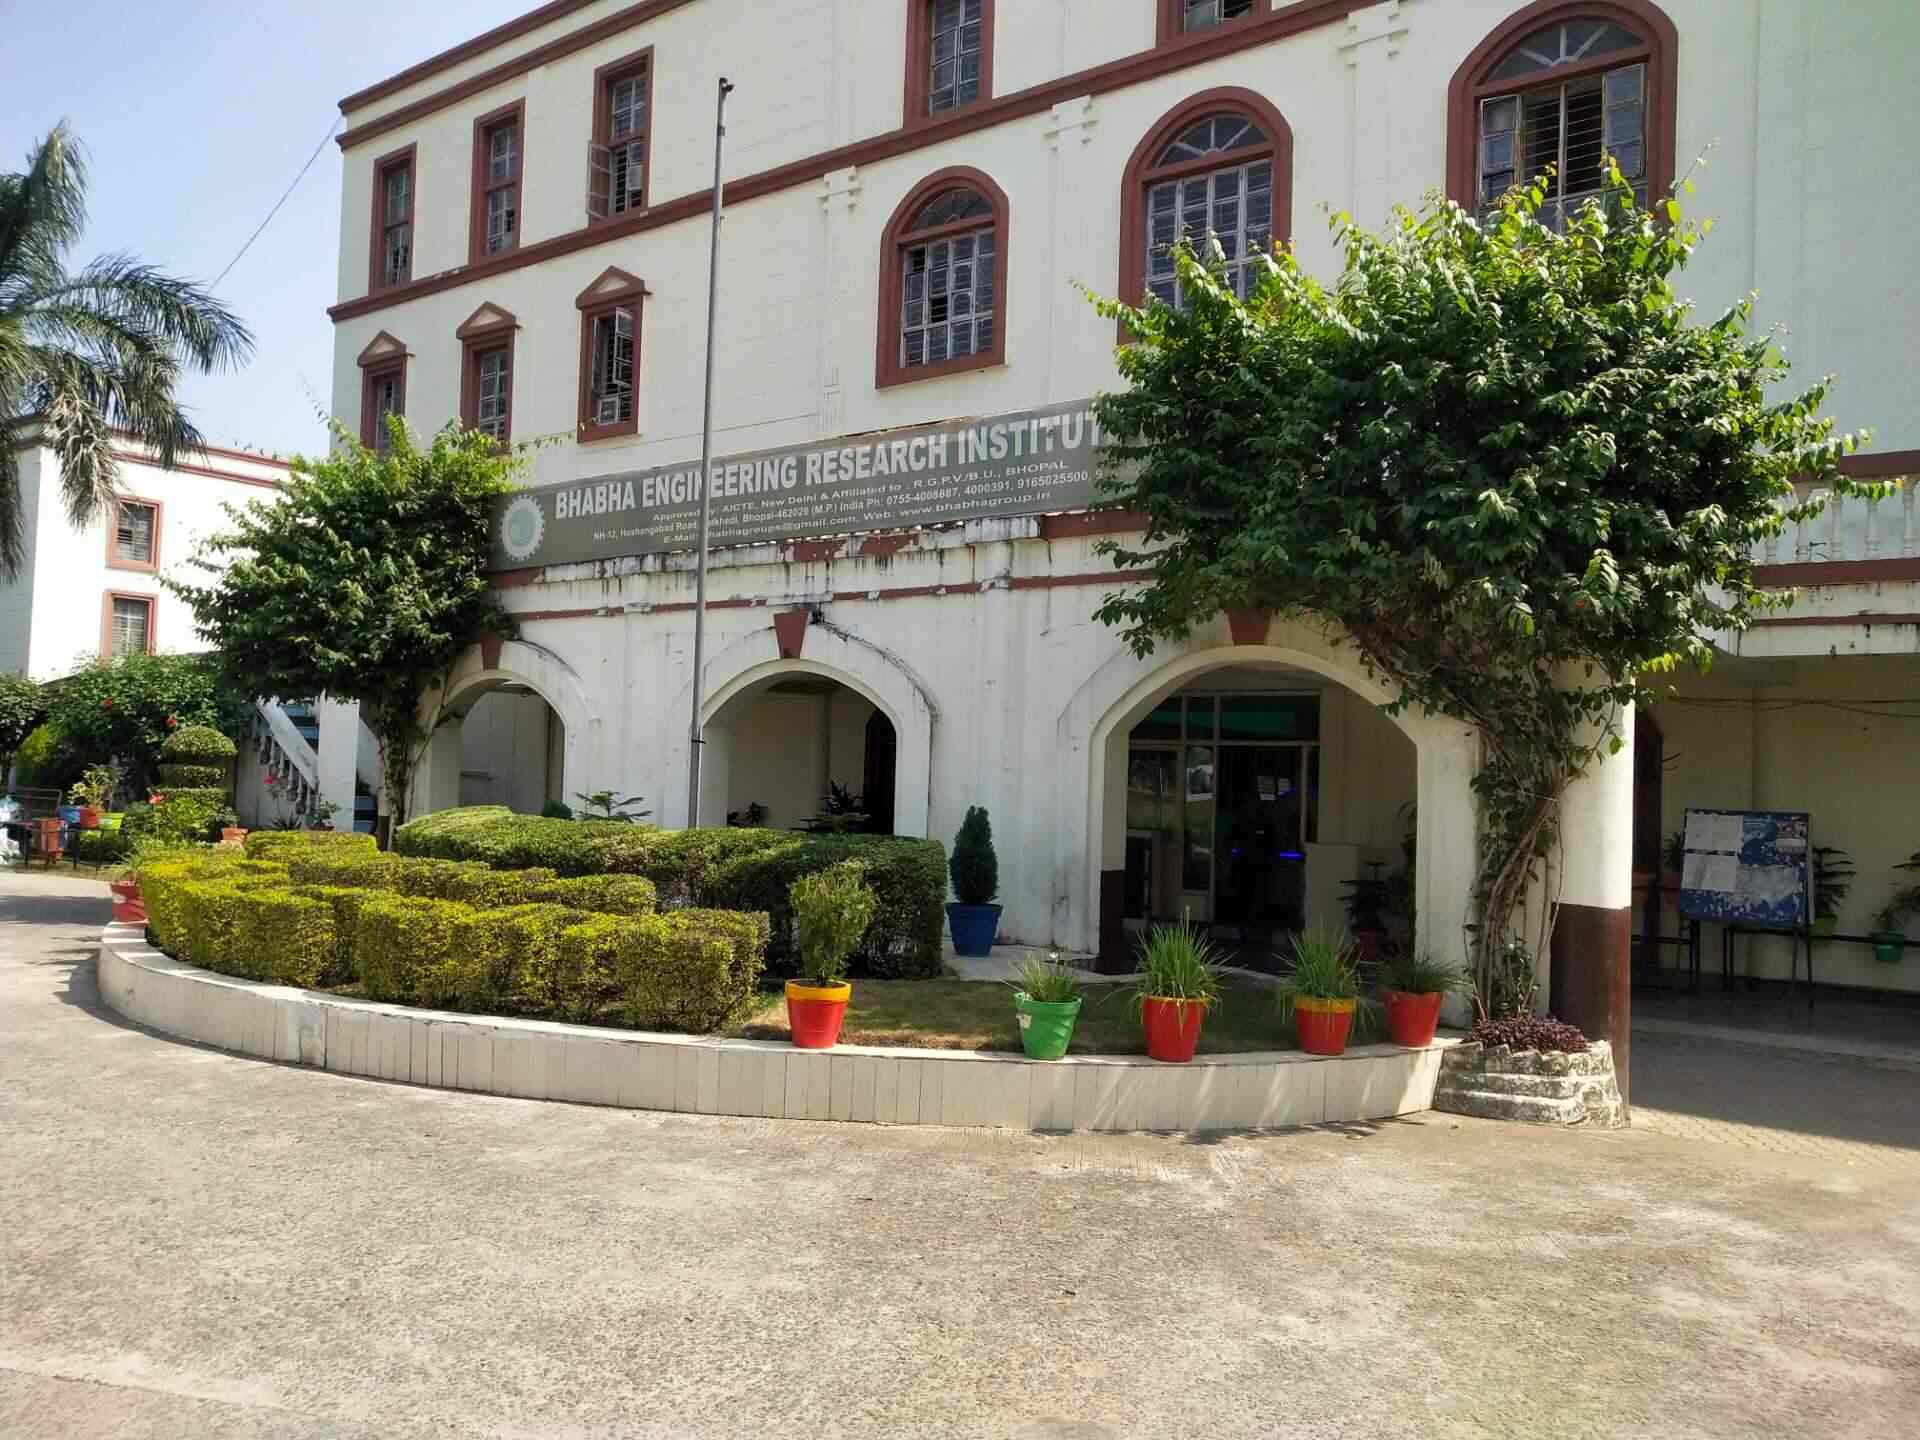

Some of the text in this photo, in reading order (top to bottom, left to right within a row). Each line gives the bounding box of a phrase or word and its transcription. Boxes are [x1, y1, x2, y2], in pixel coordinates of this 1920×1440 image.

[555, 411, 1103, 519] BHABHA ENGINEERING RESEARCH INSTITUT
[653, 508, 701, 523] Approved
[761, 499, 785, 508] New
[788, 494, 817, 505] Delhi
[832, 483, 887, 498] Affiliated
[1006, 460, 1070, 476] BHOPAL
[840, 501, 864, 513] India
